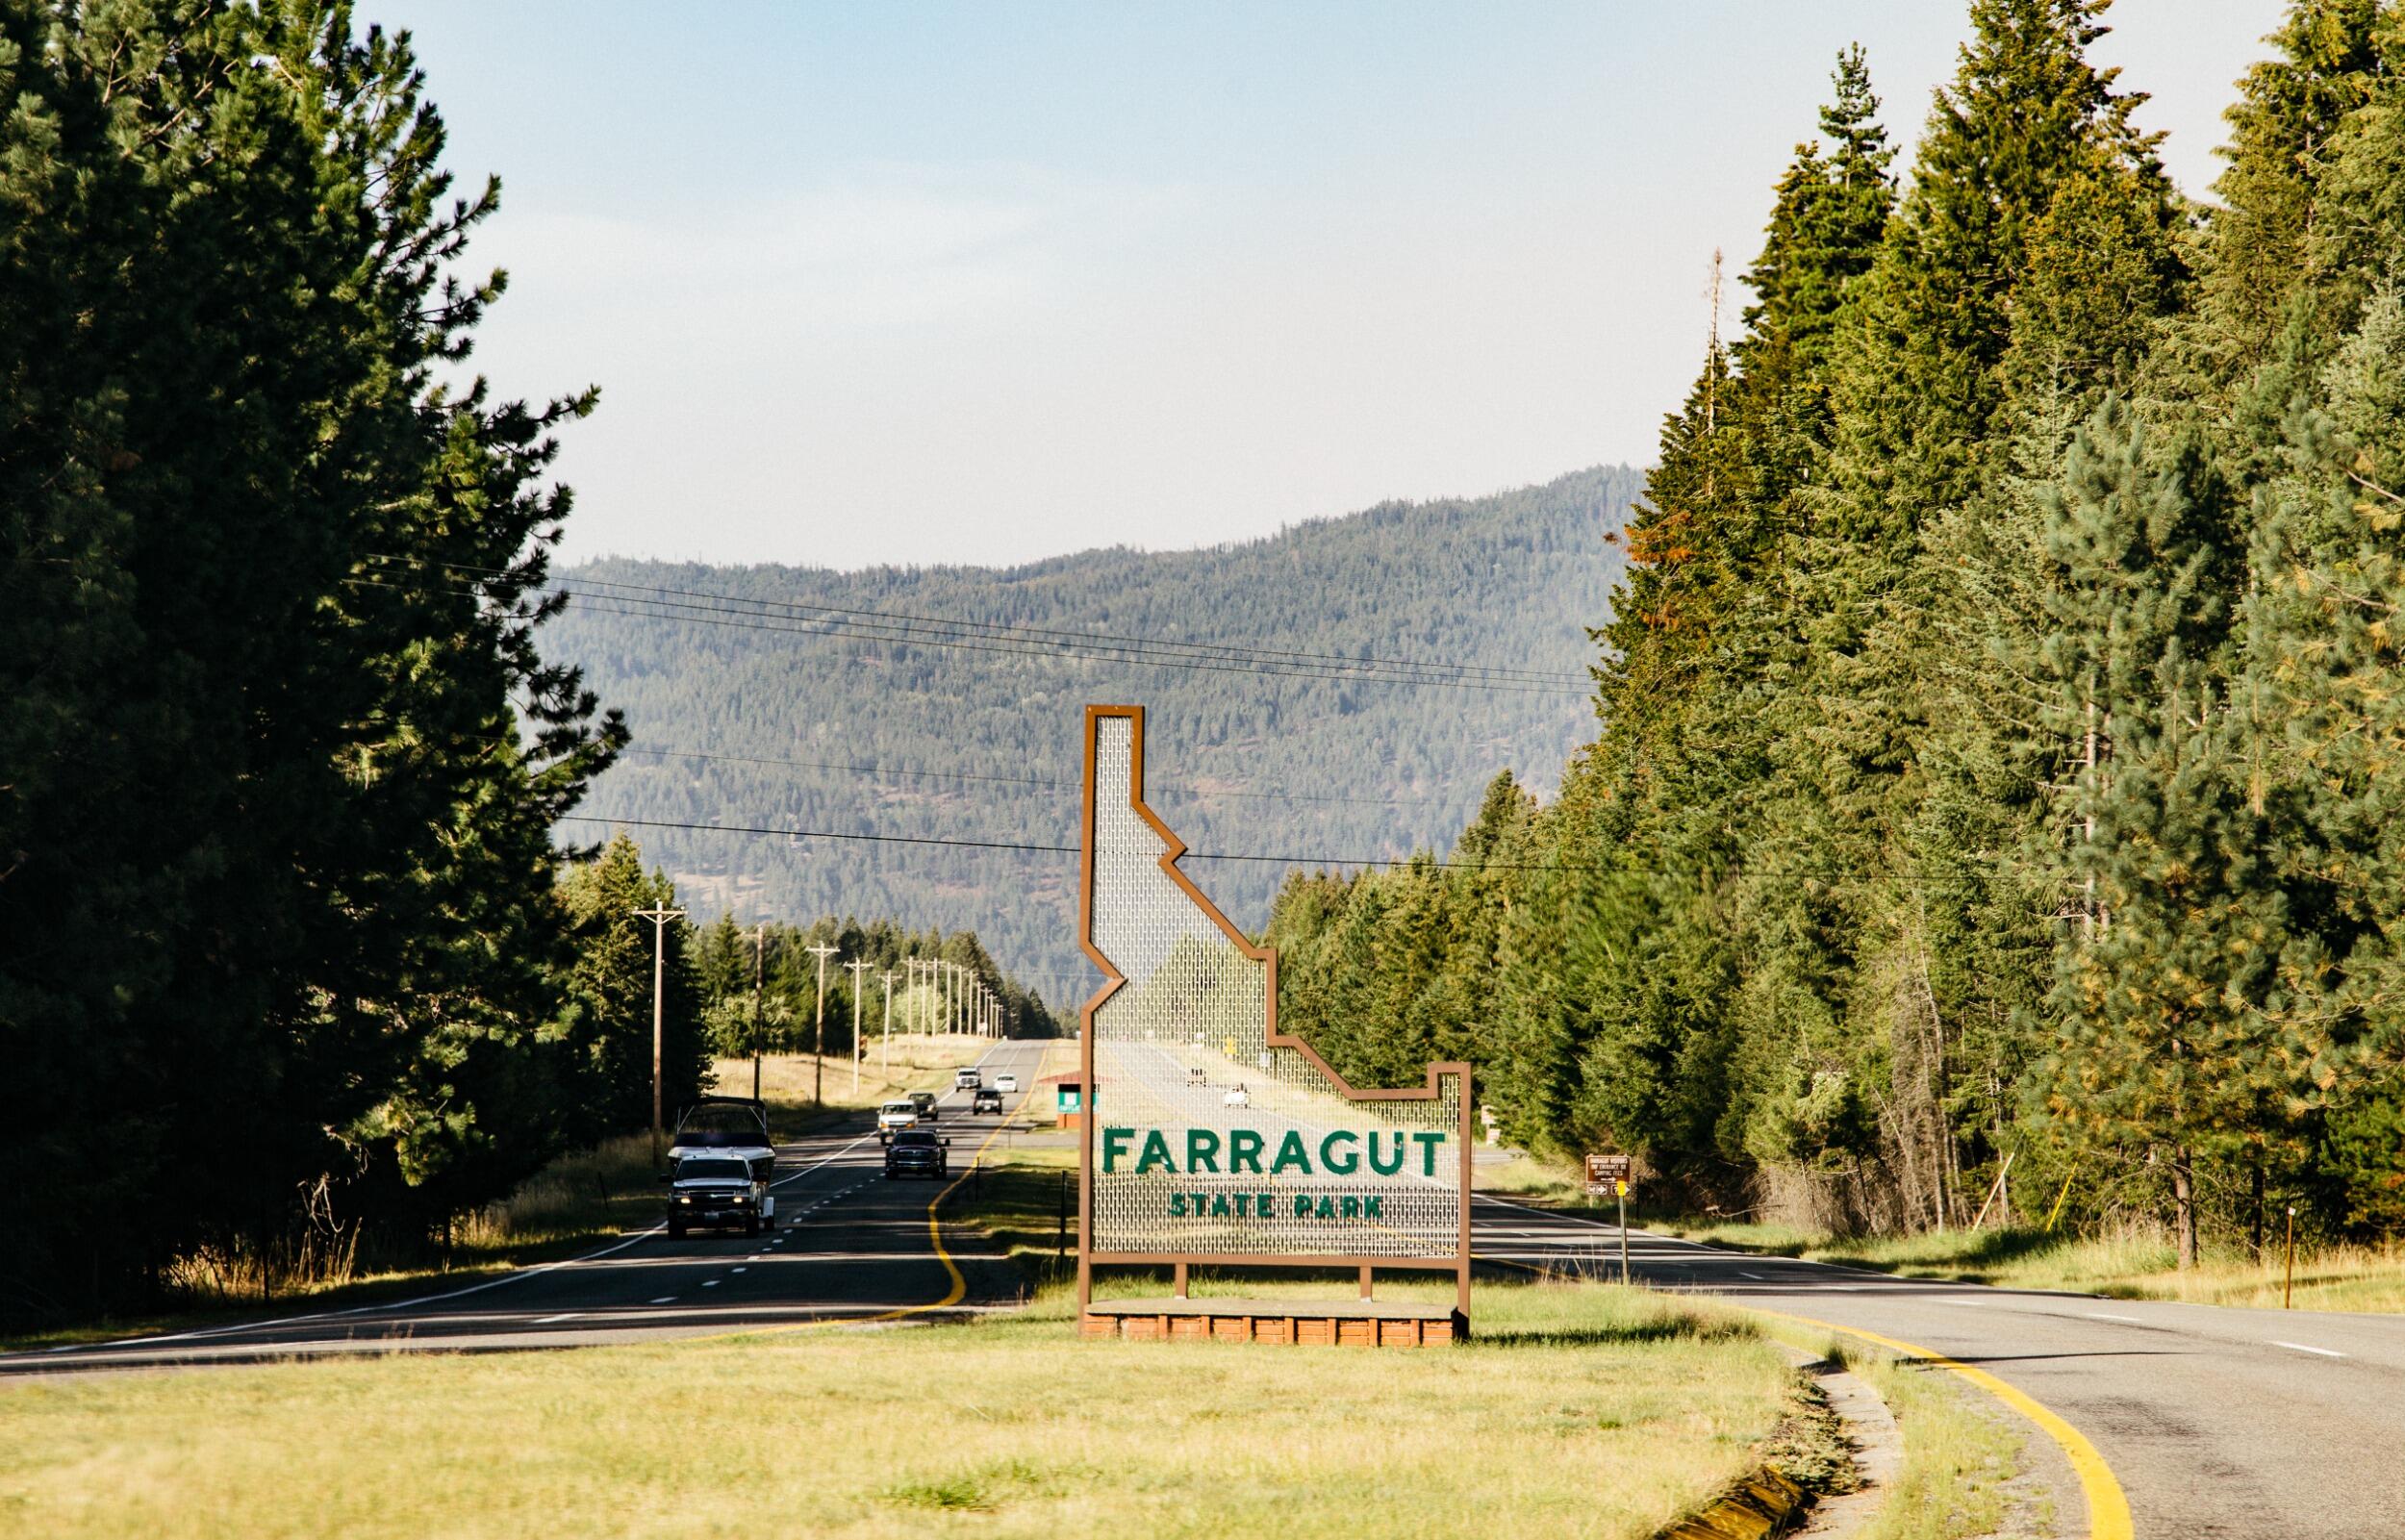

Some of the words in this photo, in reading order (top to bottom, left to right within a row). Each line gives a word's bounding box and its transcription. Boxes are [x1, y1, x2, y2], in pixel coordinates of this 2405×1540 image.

[1102, 1127, 1446, 1176] FARRAGUT
[1170, 1192, 1273, 1218] STATE
[1293, 1194, 1383, 1220] PARK
